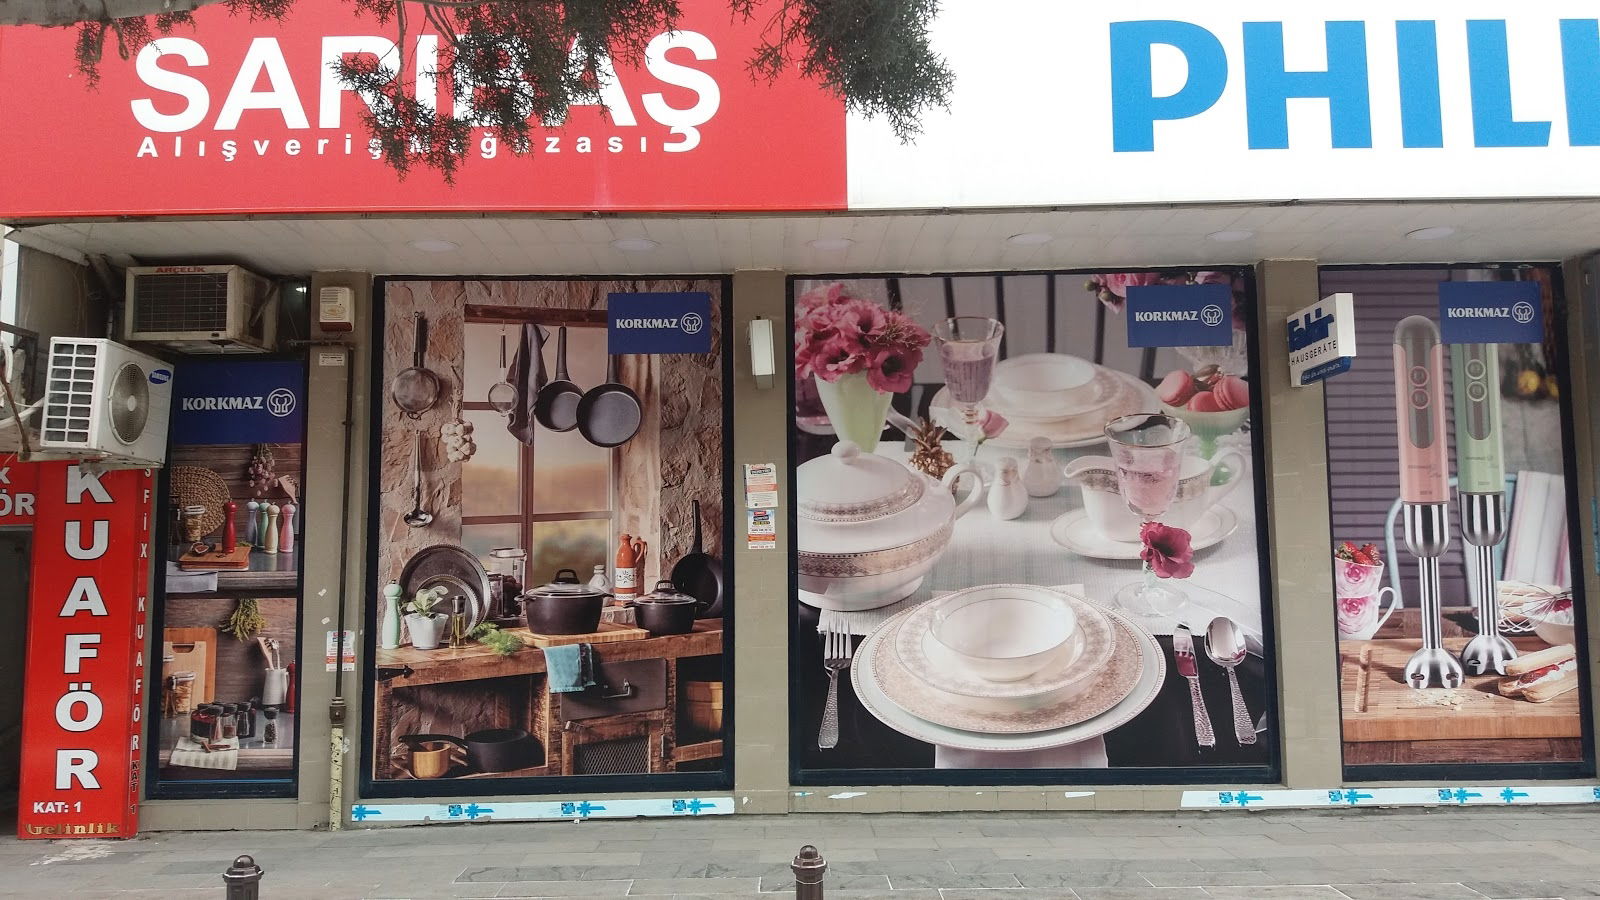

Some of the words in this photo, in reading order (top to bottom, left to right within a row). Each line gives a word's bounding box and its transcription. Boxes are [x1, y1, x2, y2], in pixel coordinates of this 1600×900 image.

[136, 133, 383, 161] Alışveriş
[1135, 310, 1199, 322] KORKMAZ
[1448, 307, 1510, 318] KORKMAZ
[615, 318, 679, 329] KORKMAZ
[182, 397, 264, 411] KORKMAZ
[55, 464, 115, 790] KUAFÖR
[33, 801, 70, 814] KAT:
[74, 800, 82, 813] 1
